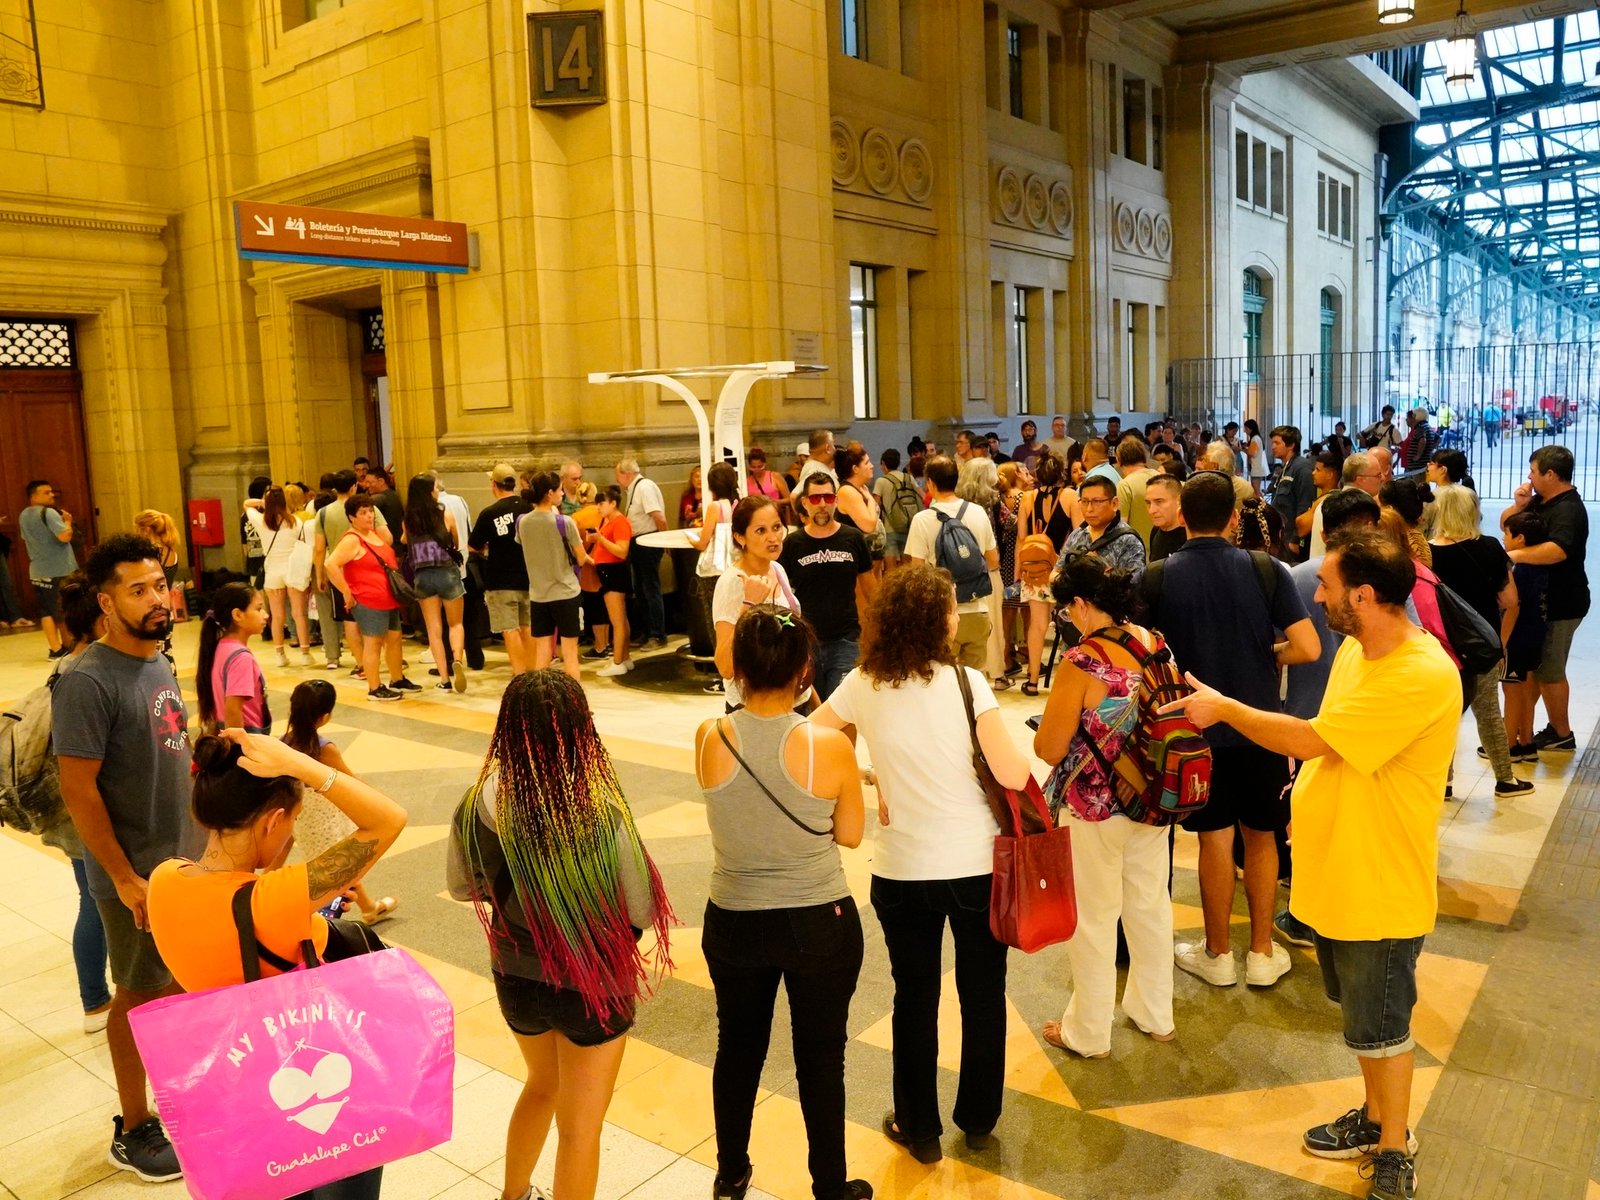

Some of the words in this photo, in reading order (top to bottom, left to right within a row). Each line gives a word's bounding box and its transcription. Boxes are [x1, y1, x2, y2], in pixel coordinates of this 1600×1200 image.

[541, 25, 592, 92] 14
[309, 221, 345, 233] Boletería
[344, 226, 351, 235] y
[352, 225, 400, 240] Preembarque
[400, 230, 420, 242] Larga
[420, 231, 452, 243] Distancia
[493, 512, 514, 528] EASY
[497, 524, 509, 536] GO
[227, 1032, 254, 1068] MY
[262, 1003, 334, 1038] BIKINI
[346, 1009, 367, 1031] IS
[266, 1143, 351, 1177] Guadalupe
